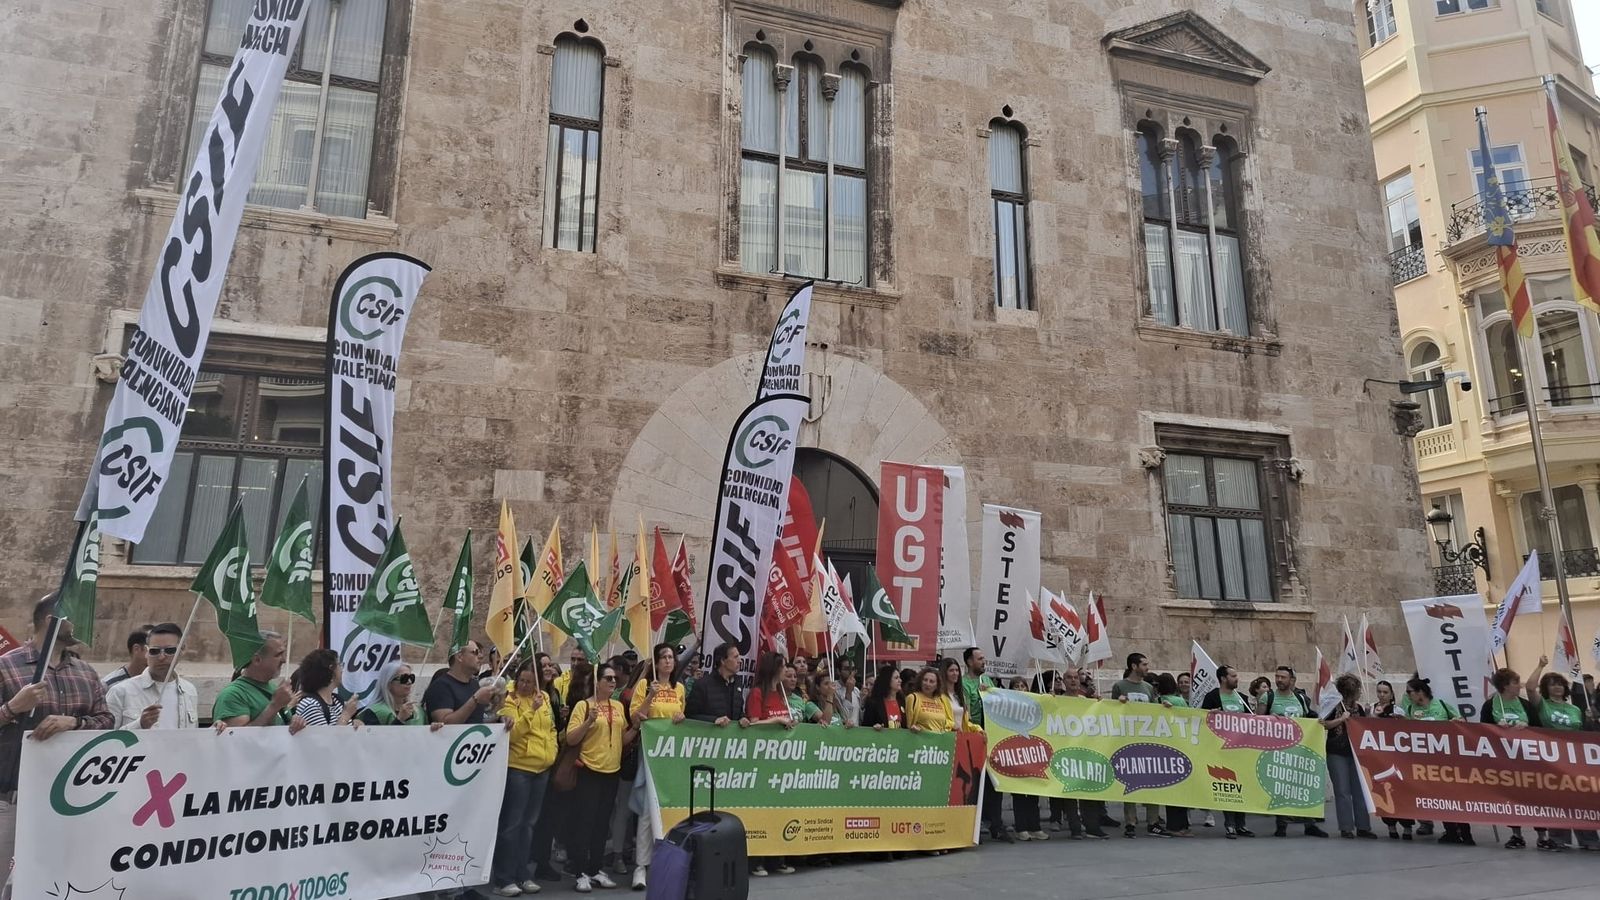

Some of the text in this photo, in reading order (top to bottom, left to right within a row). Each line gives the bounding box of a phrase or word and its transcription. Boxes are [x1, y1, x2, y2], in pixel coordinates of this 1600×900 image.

[161, 57, 255, 359] CSIF
[357, 293, 404, 326] CSIF
[750, 430, 791, 456] CSIF
[100, 444, 162, 503] CSIF
[893, 476, 927, 623] UGT
[711, 501, 760, 656] CSIF
[994, 531, 1015, 658] STEPV
[455, 743, 496, 765] CSIF
[648, 736, 949, 765] JA N'HI HA PROU! -burocràcia -ràtios
[1273, 750, 1316, 772] CENTRES
[1360, 730, 1450, 755] ALCEM
[1457, 735, 1496, 758] LA
[1500, 738, 1560, 762] VEU
[1566, 742, 1577, 764] I
[73, 756, 146, 786] CSIF
[1055, 757, 1107, 784] +SALARI
[1115, 756, 1185, 775] +PLANTILLES
[1266, 765, 1321, 789] EDUCATIUS
[1412, 764, 1600, 793] RECLASSIFICACI
[693, 767, 922, 793] +salari +plantilla +valencià
[1212, 782, 1242, 793] STEPV
[1274, 781, 1310, 802] DIGNES
[132, 769, 410, 828] X LA MEJORA DE LAS
[1415, 797, 1464, 811] PERSONAL
[1514, 804, 1566, 819] EDUCATIVA
[845, 830, 879, 839] educació
[891, 822, 911, 834] UGT
[110, 813, 449, 872] CONDICIONES LABORALES
